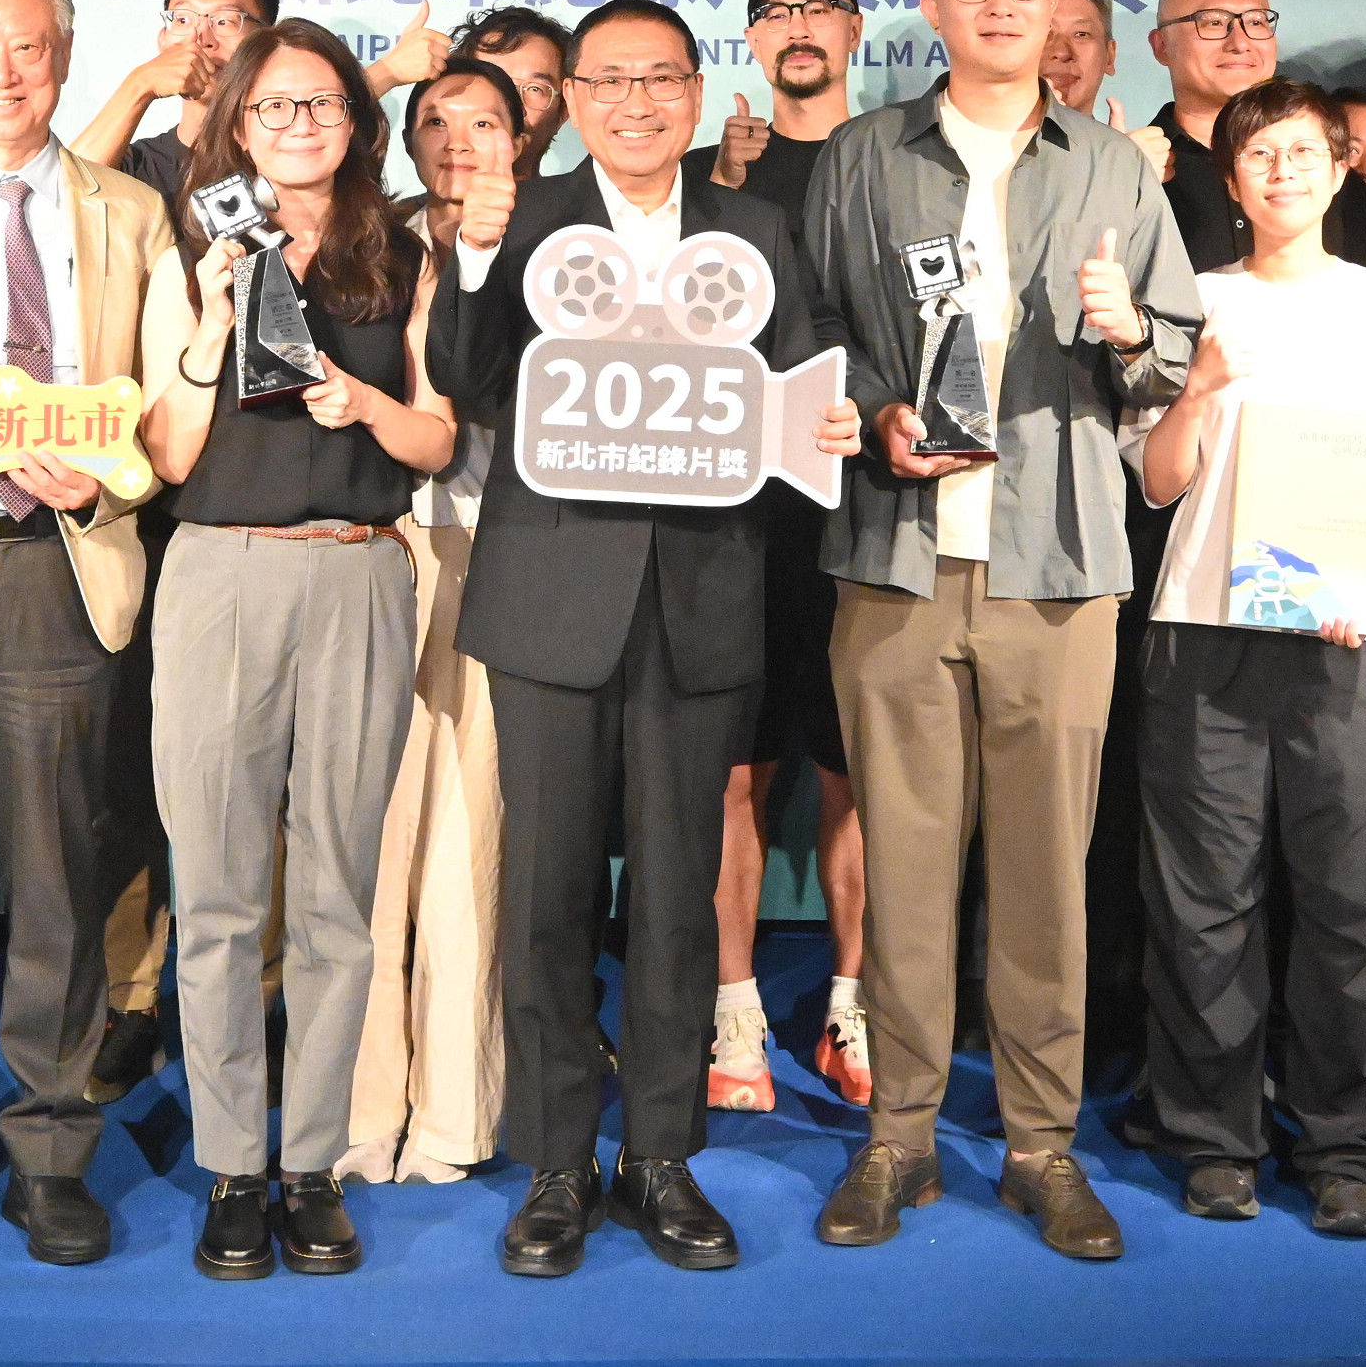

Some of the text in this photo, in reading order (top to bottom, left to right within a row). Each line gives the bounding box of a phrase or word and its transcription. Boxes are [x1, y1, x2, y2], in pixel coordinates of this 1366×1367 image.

[540, 357, 746, 436] 2025
[535, 438, 749, 480] 新北市紀錄片獎
